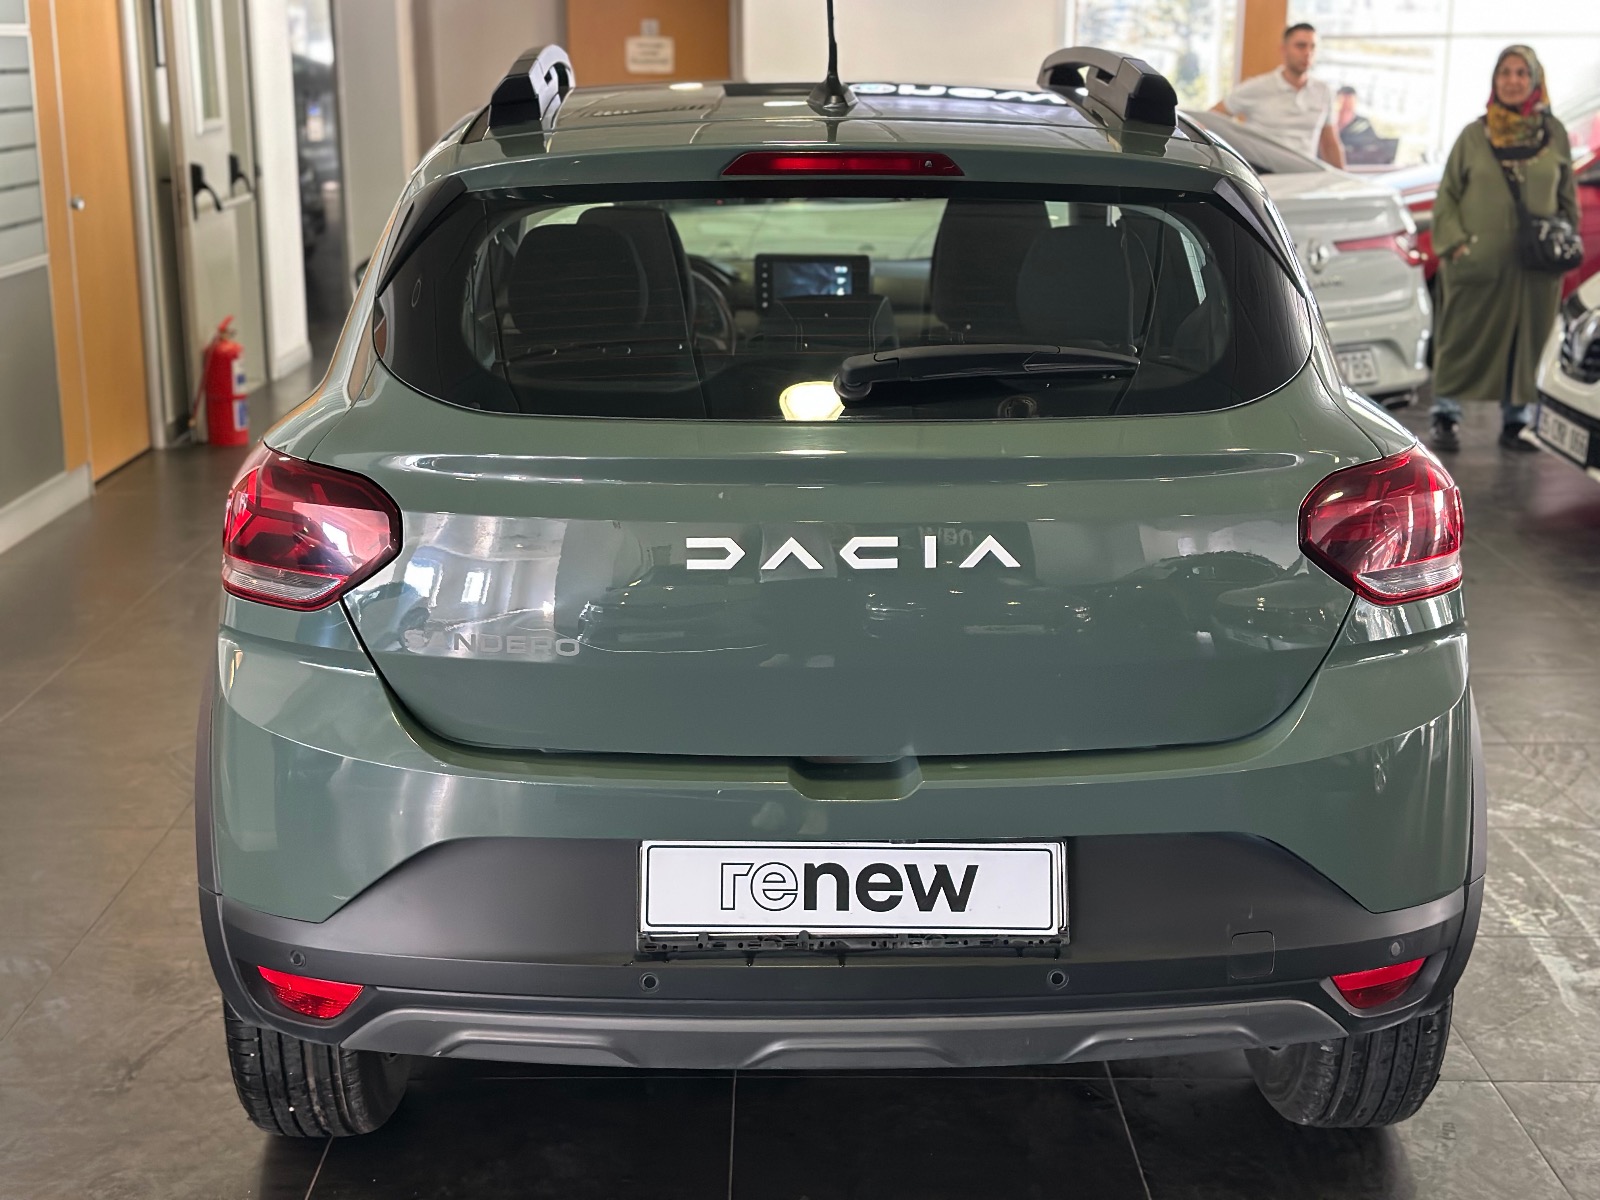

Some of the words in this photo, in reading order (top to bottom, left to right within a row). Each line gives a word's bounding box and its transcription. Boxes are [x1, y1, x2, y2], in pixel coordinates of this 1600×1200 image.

[685, 534, 1021, 570] DACIA
[404, 629, 580, 657] SANDERO
[720, 861, 979, 913] renew
